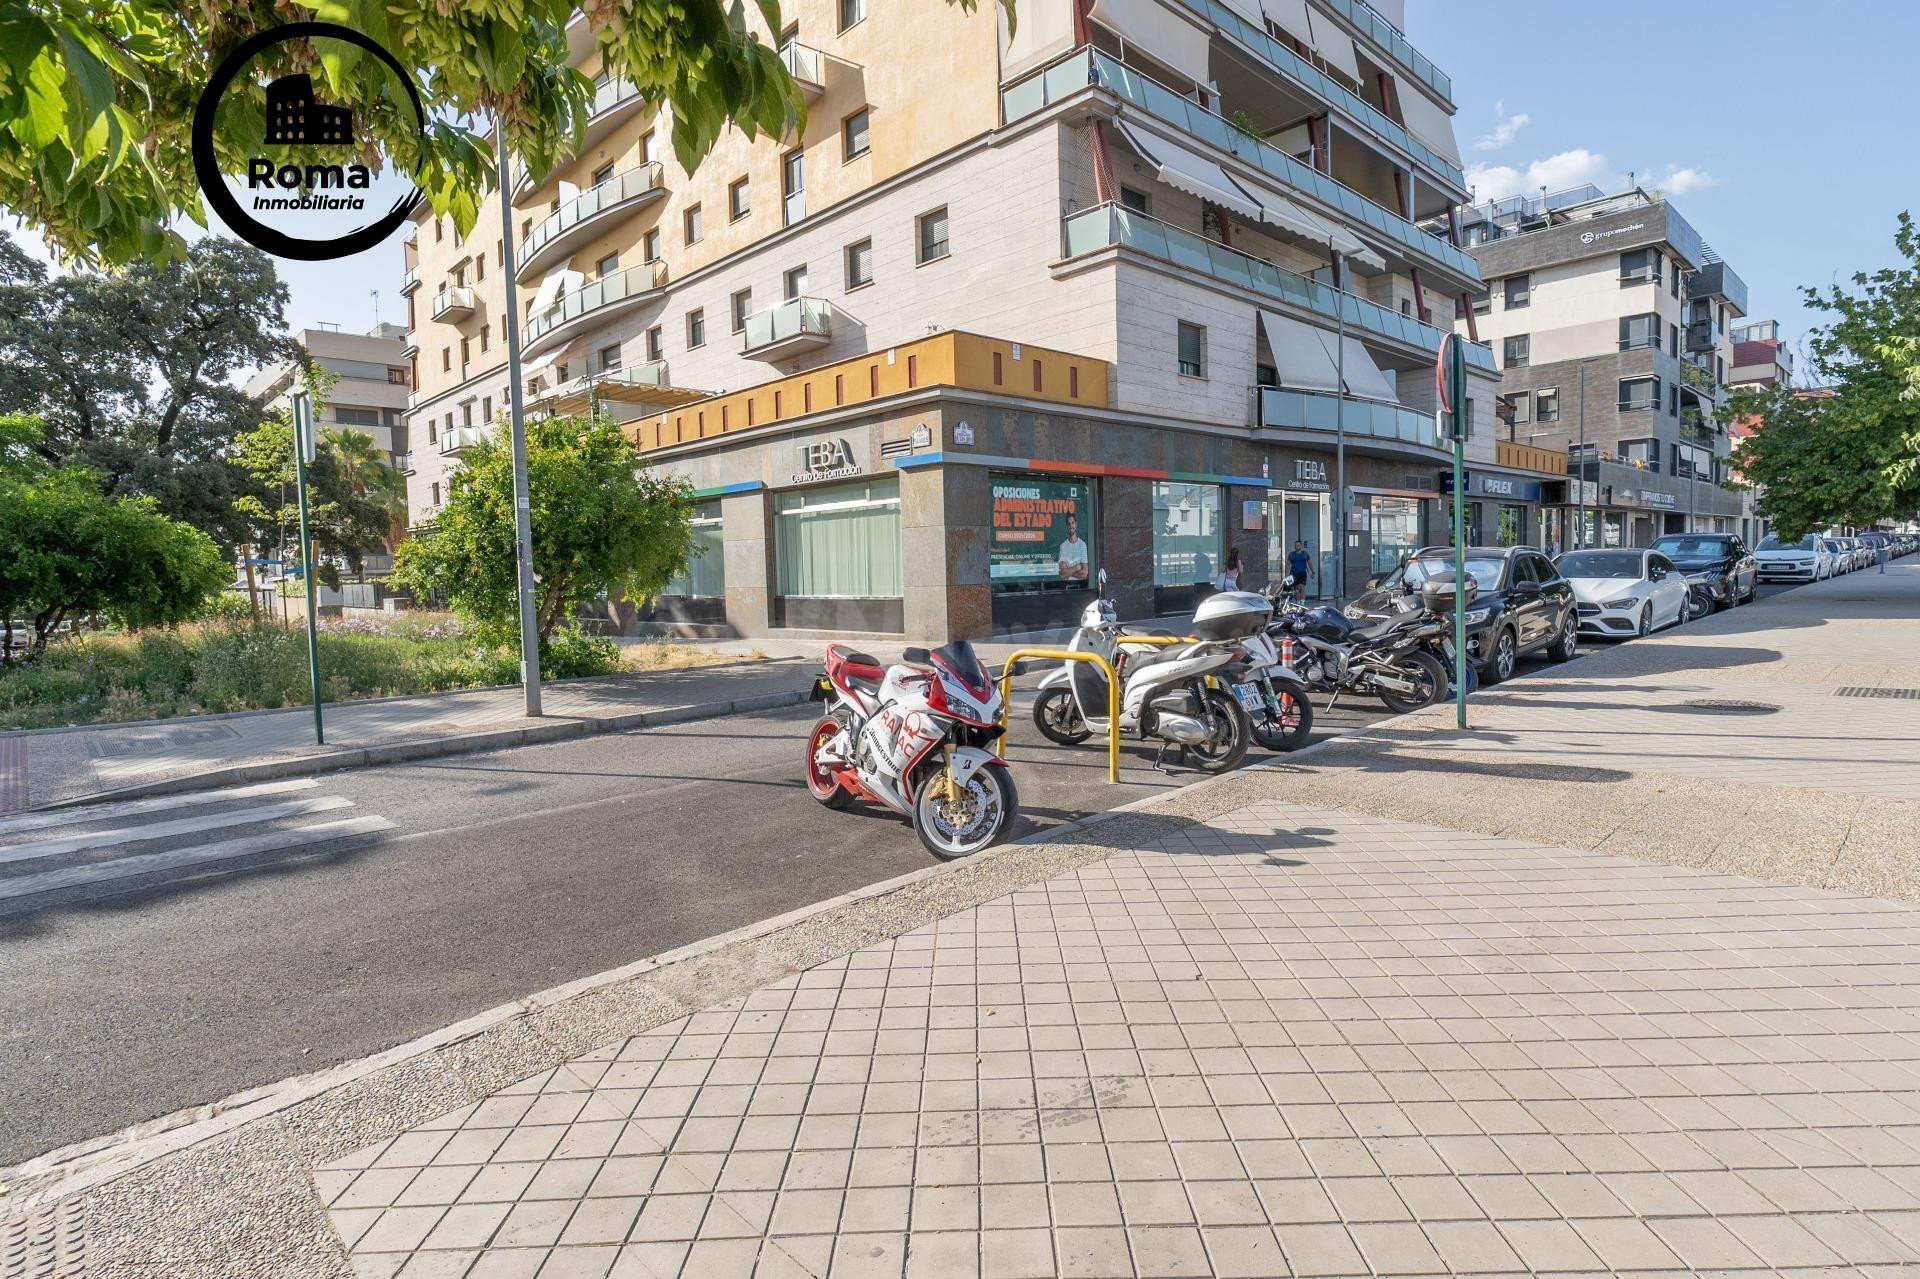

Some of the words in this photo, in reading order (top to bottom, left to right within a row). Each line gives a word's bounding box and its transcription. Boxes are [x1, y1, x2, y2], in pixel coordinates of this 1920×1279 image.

[796, 436, 849, 470] TEBA
[791, 472, 814, 484] Centro
[814, 470, 824, 480] de
[824, 465, 862, 480] Formación
[1294, 459, 1327, 481] TEBA
[1288, 479, 1303, 488] Centro
[1303, 481, 1309, 489] de
[993, 486, 1041, 499] OPOSICIONES
[993, 498, 1076, 513] ADMINISTRATIVO
[993, 512, 1011, 526] DEL
[1014, 513, 1052, 528] ESTADO
[1240, 684, 1258, 696] 2802
